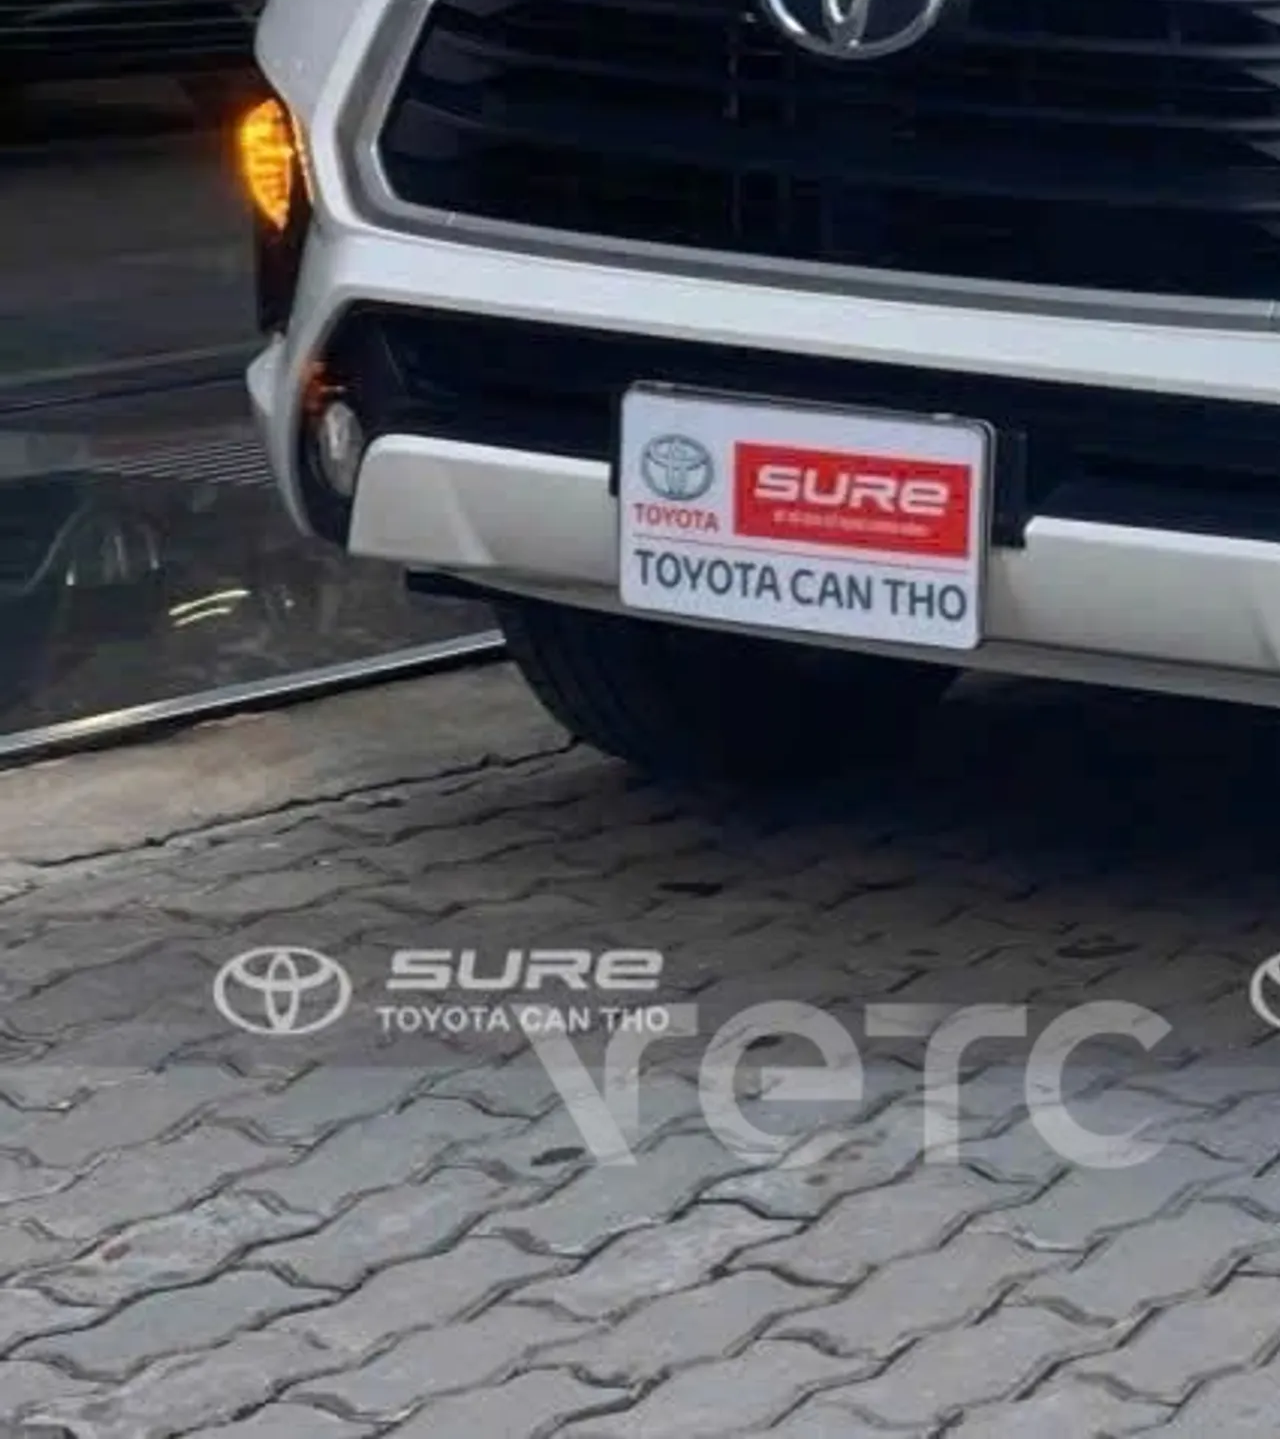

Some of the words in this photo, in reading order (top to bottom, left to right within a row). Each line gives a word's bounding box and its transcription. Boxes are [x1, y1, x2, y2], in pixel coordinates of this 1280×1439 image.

[754, 463, 951, 517] SURE
[633, 502, 720, 534] TOYOTA
[634, 548, 782, 604] TOYOTA
[790, 569, 873, 616] CAN
[882, 578, 968, 622] THO
